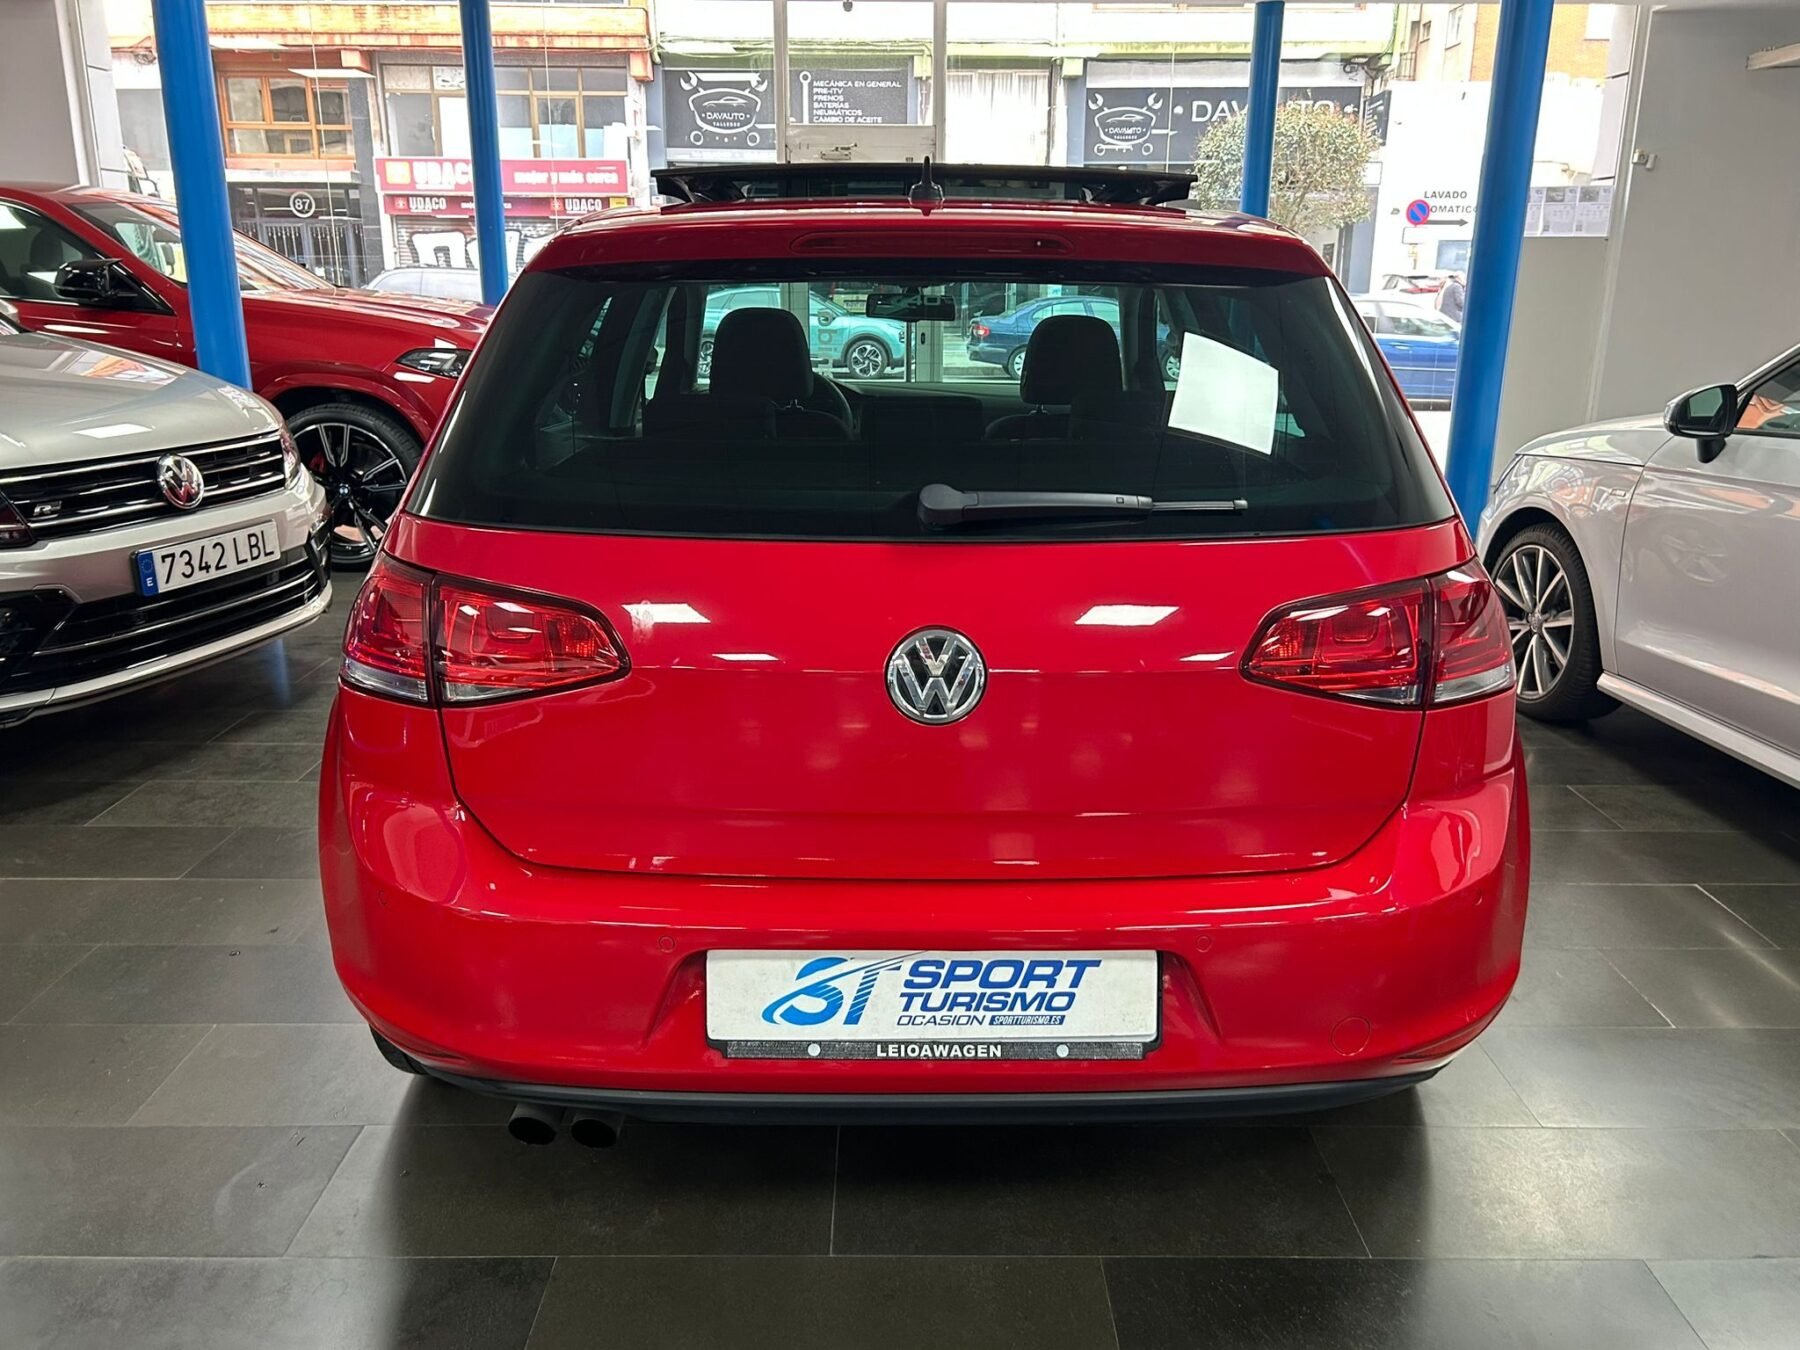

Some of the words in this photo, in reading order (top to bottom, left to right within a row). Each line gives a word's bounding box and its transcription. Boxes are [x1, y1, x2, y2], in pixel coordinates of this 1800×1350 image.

[706, 112, 745, 120] DAVAUTO
[1424, 191, 1467, 199] LAVADO
[294, 198, 309, 210] 87
[409, 196, 447, 210] UDACO
[565, 198, 602, 211] UDACO
[161, 542, 227, 584] 7342
[233, 530, 275, 565] LBL
[903, 959, 1102, 989] SPORT
[900, 991, 1077, 1013] TURISMO
[897, 1014, 986, 1026] OCASION
[993, 1015, 1062, 1025] SPORTTURISMO.ES
[876, 1043, 1002, 1058] LEIOAWAGEN
